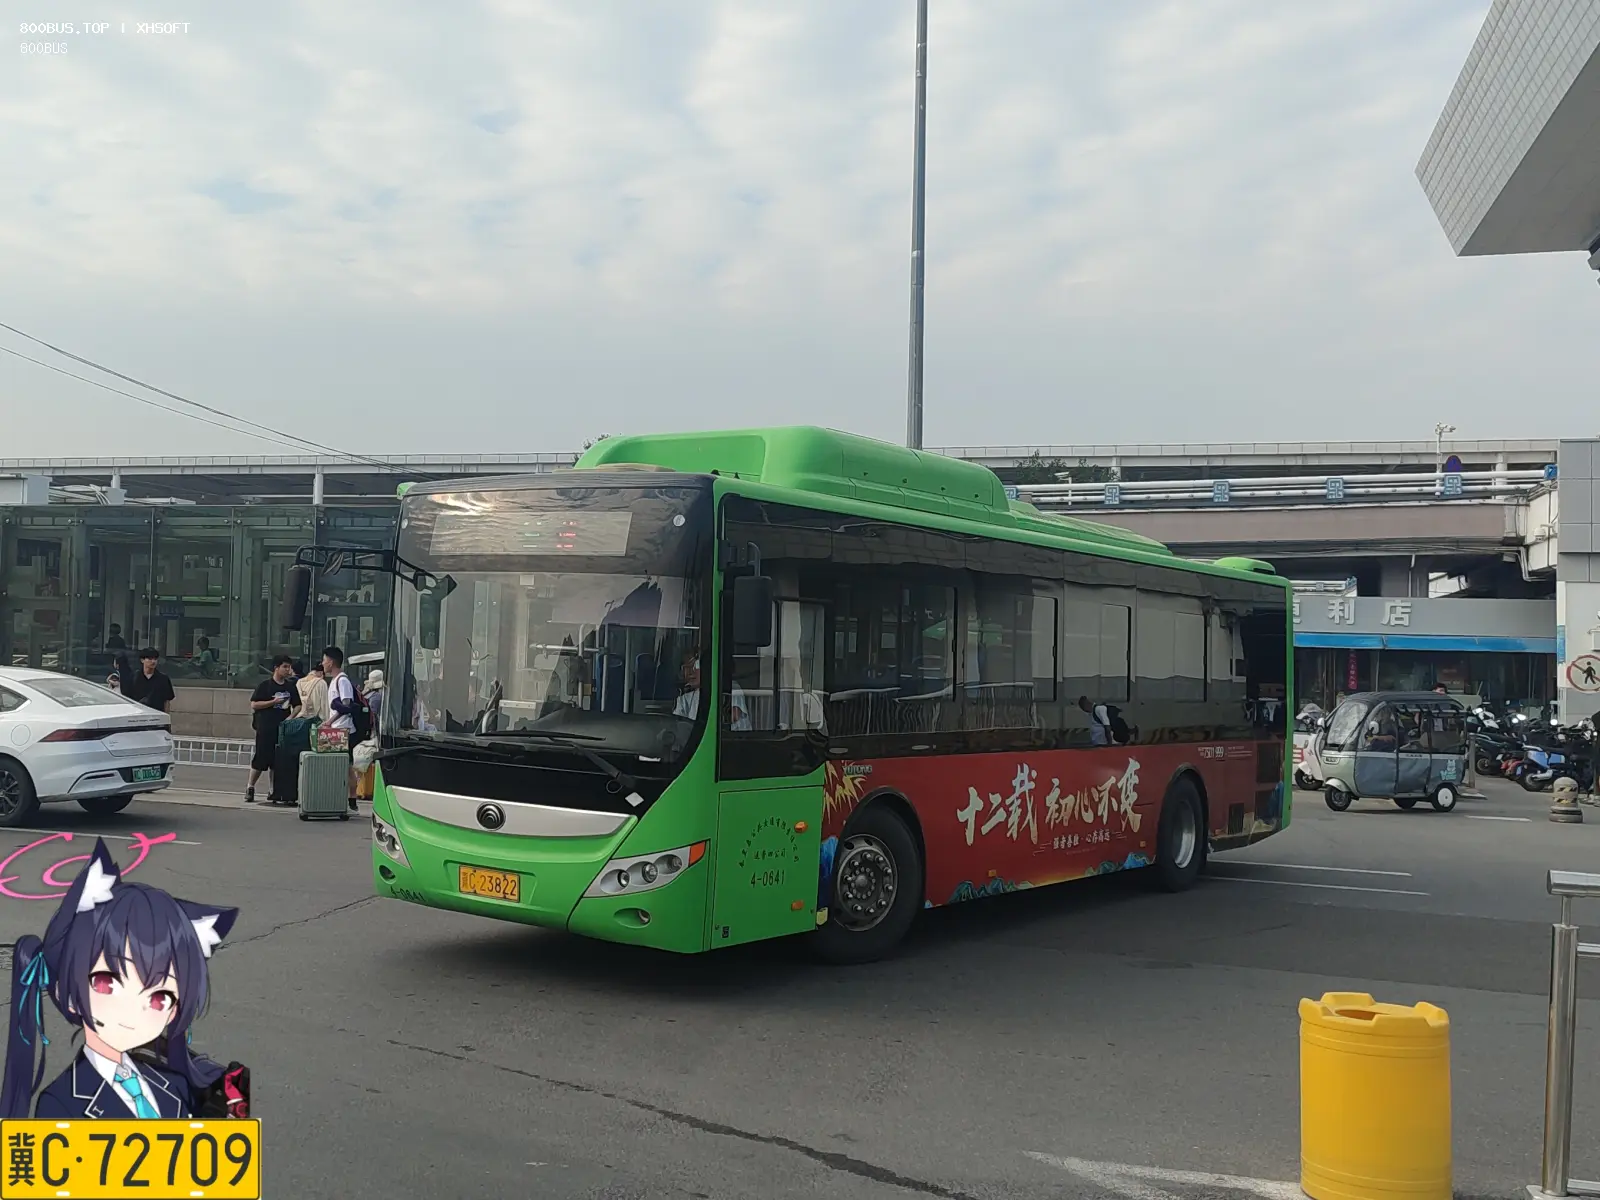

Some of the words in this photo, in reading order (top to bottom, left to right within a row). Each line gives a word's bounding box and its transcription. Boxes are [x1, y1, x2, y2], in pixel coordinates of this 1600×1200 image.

[1293, 598, 1412, 627] 利店
[842, 764, 873, 776] YUTONG
[750, 869, 785, 888] 4-0641
[389, 885, 426, 903] 4-0641
